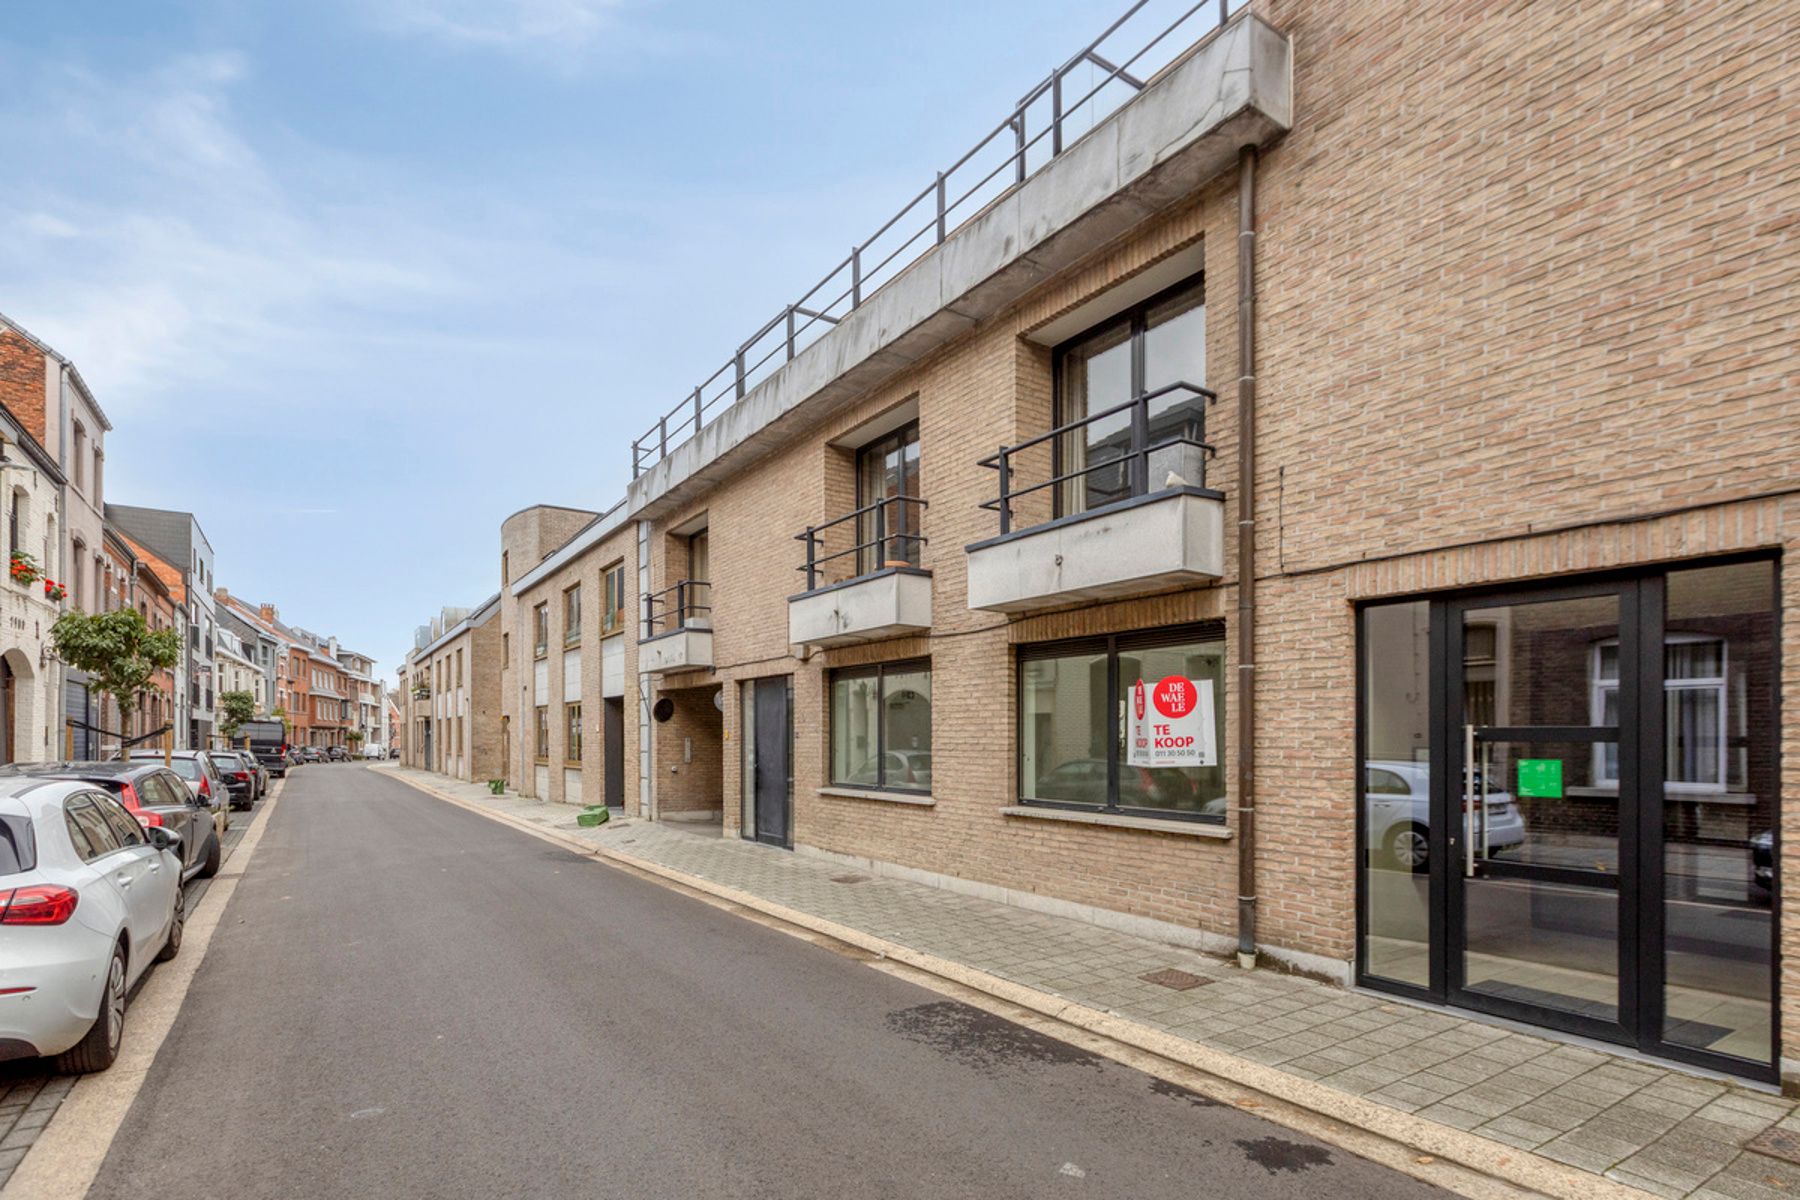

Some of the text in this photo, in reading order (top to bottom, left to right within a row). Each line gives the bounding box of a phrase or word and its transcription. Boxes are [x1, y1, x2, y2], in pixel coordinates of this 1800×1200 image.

[1169, 682, 1185, 693] DE
[1160, 693, 1186, 703] WAE
[1171, 703, 1186, 713] LE
[1153, 724, 1171, 736] TE
[1155, 736, 1194, 749] KOOP
